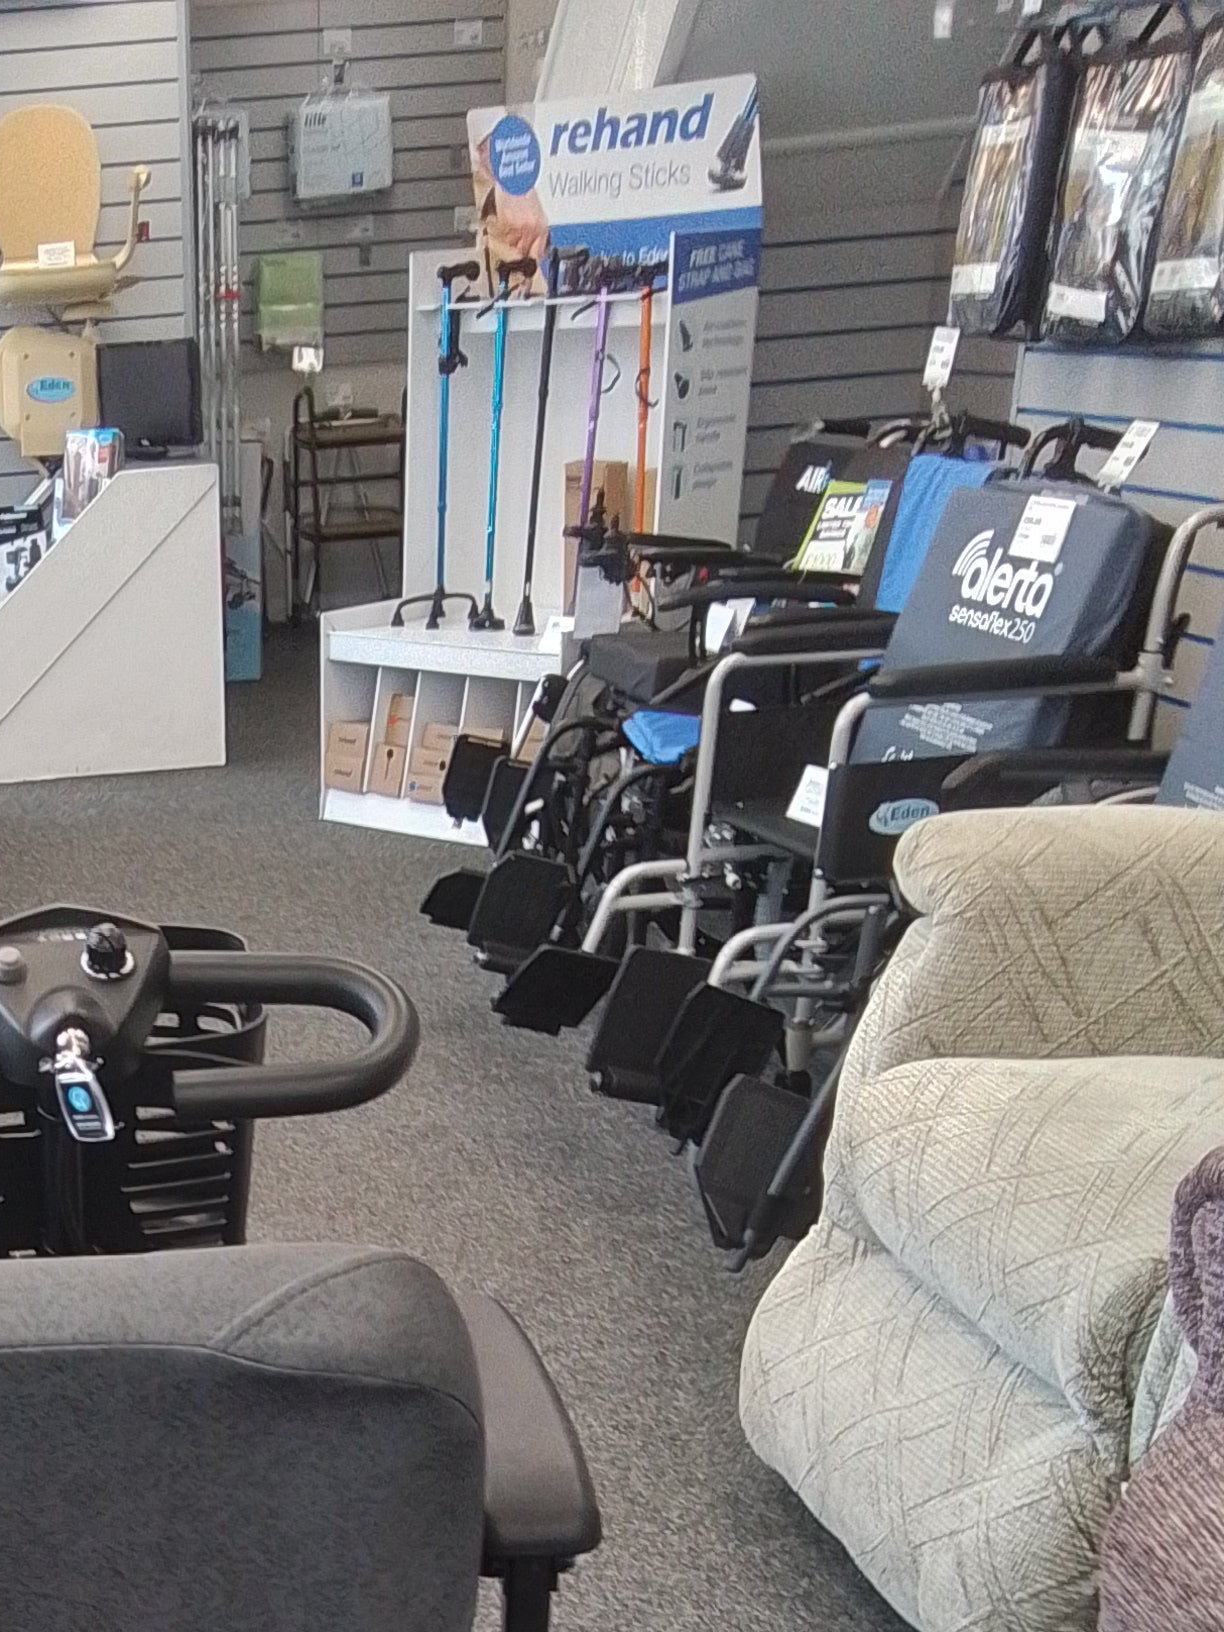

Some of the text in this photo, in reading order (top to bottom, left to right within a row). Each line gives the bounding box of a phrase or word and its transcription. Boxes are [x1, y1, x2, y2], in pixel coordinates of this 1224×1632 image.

[549, 92, 715, 156] rehand
[549, 160, 690, 198] Walking Sticks
[960, 547, 1054, 619] alerta
[890, 804, 931, 822] Eden
